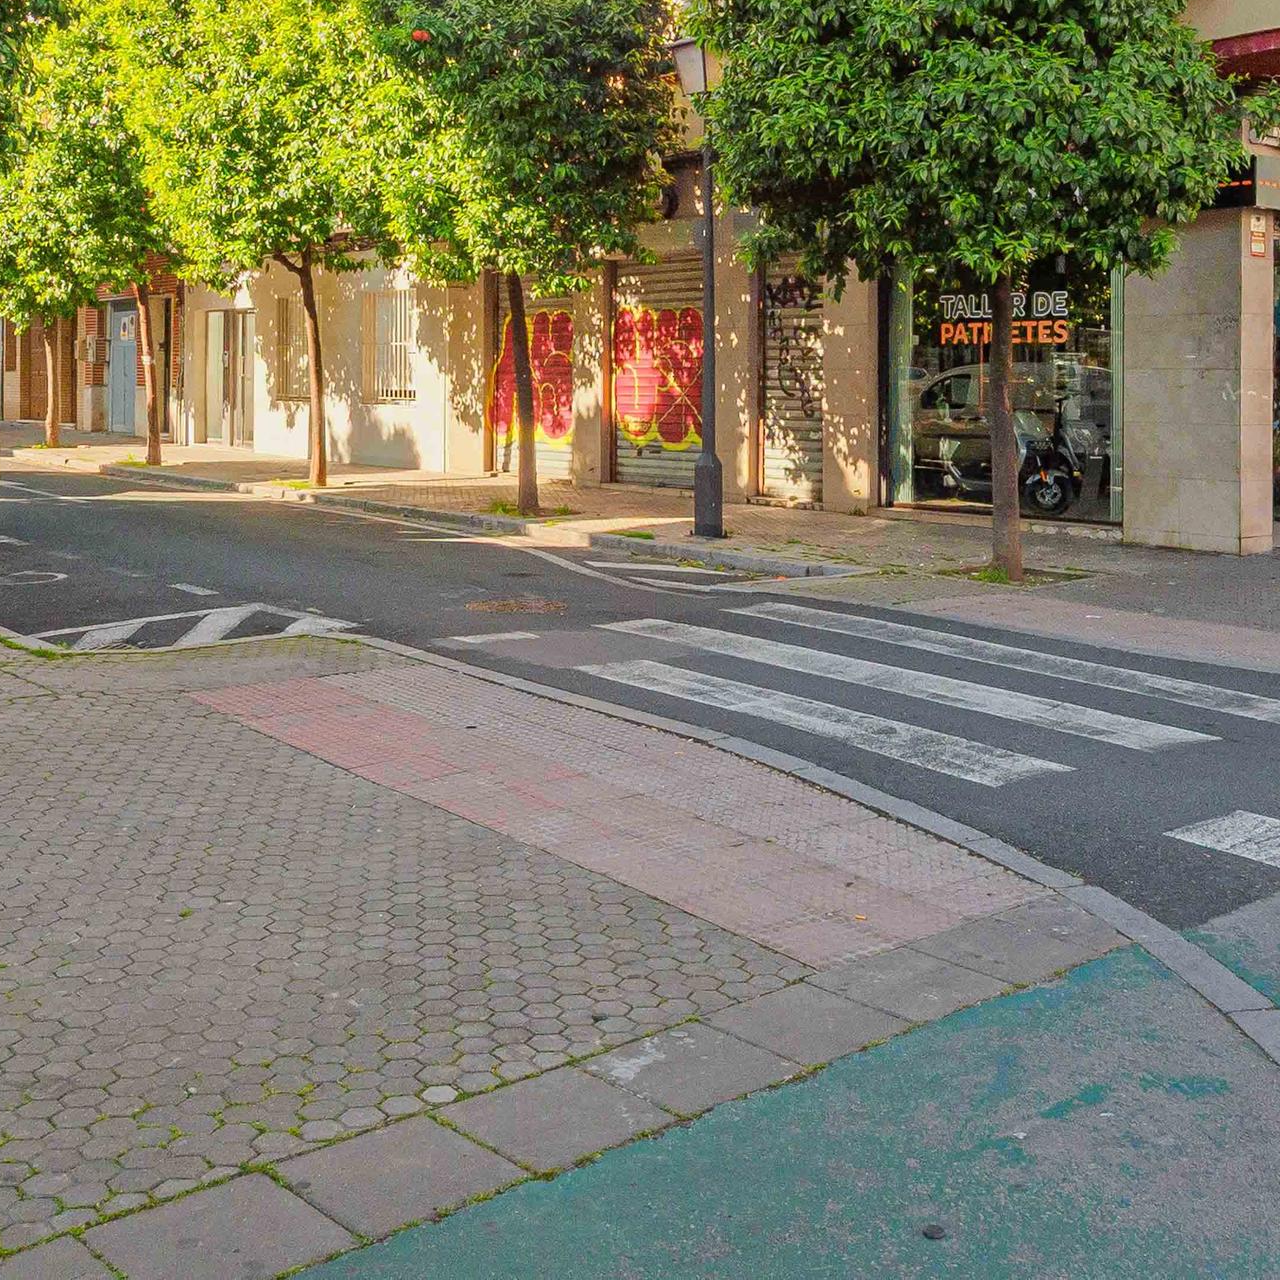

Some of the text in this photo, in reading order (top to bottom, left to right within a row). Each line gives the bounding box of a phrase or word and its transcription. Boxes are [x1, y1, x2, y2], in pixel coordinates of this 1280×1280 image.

[939, 292, 1027, 319] TALLR
[1033, 290, 1069, 317] DE
[940, 320, 1069, 345] PATIETES
